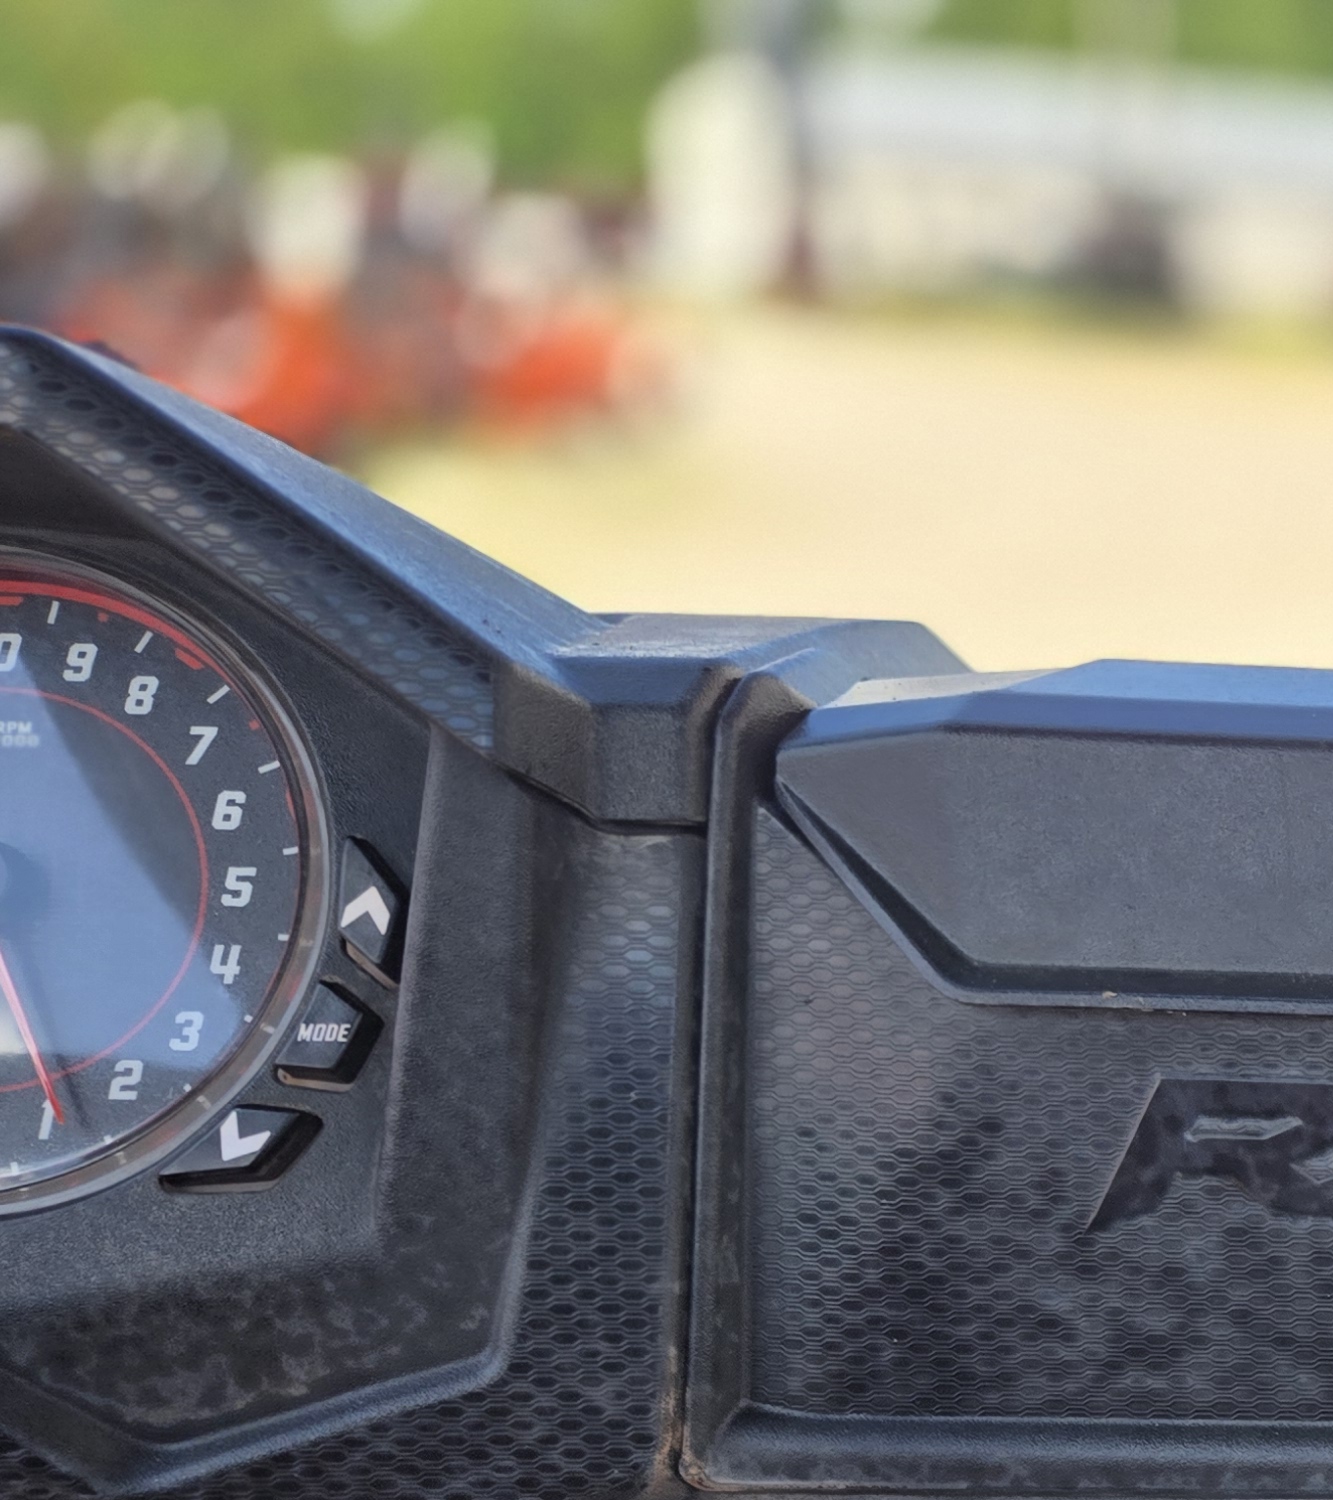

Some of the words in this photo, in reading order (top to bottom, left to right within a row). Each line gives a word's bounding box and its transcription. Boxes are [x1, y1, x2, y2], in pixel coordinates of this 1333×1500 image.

[62, 643, 98, 682] 9
[124, 676, 159, 715] 8
[185, 726, 219, 765] 7
[211, 790, 247, 830] 6
[221, 867, 257, 907] 5
[210, 945, 242, 984] 4
[169, 1012, 204, 1051] 3
[297, 1023, 351, 1042] MODE
[108, 1060, 143, 1100] 2
[38, 1099, 56, 1140] 1
